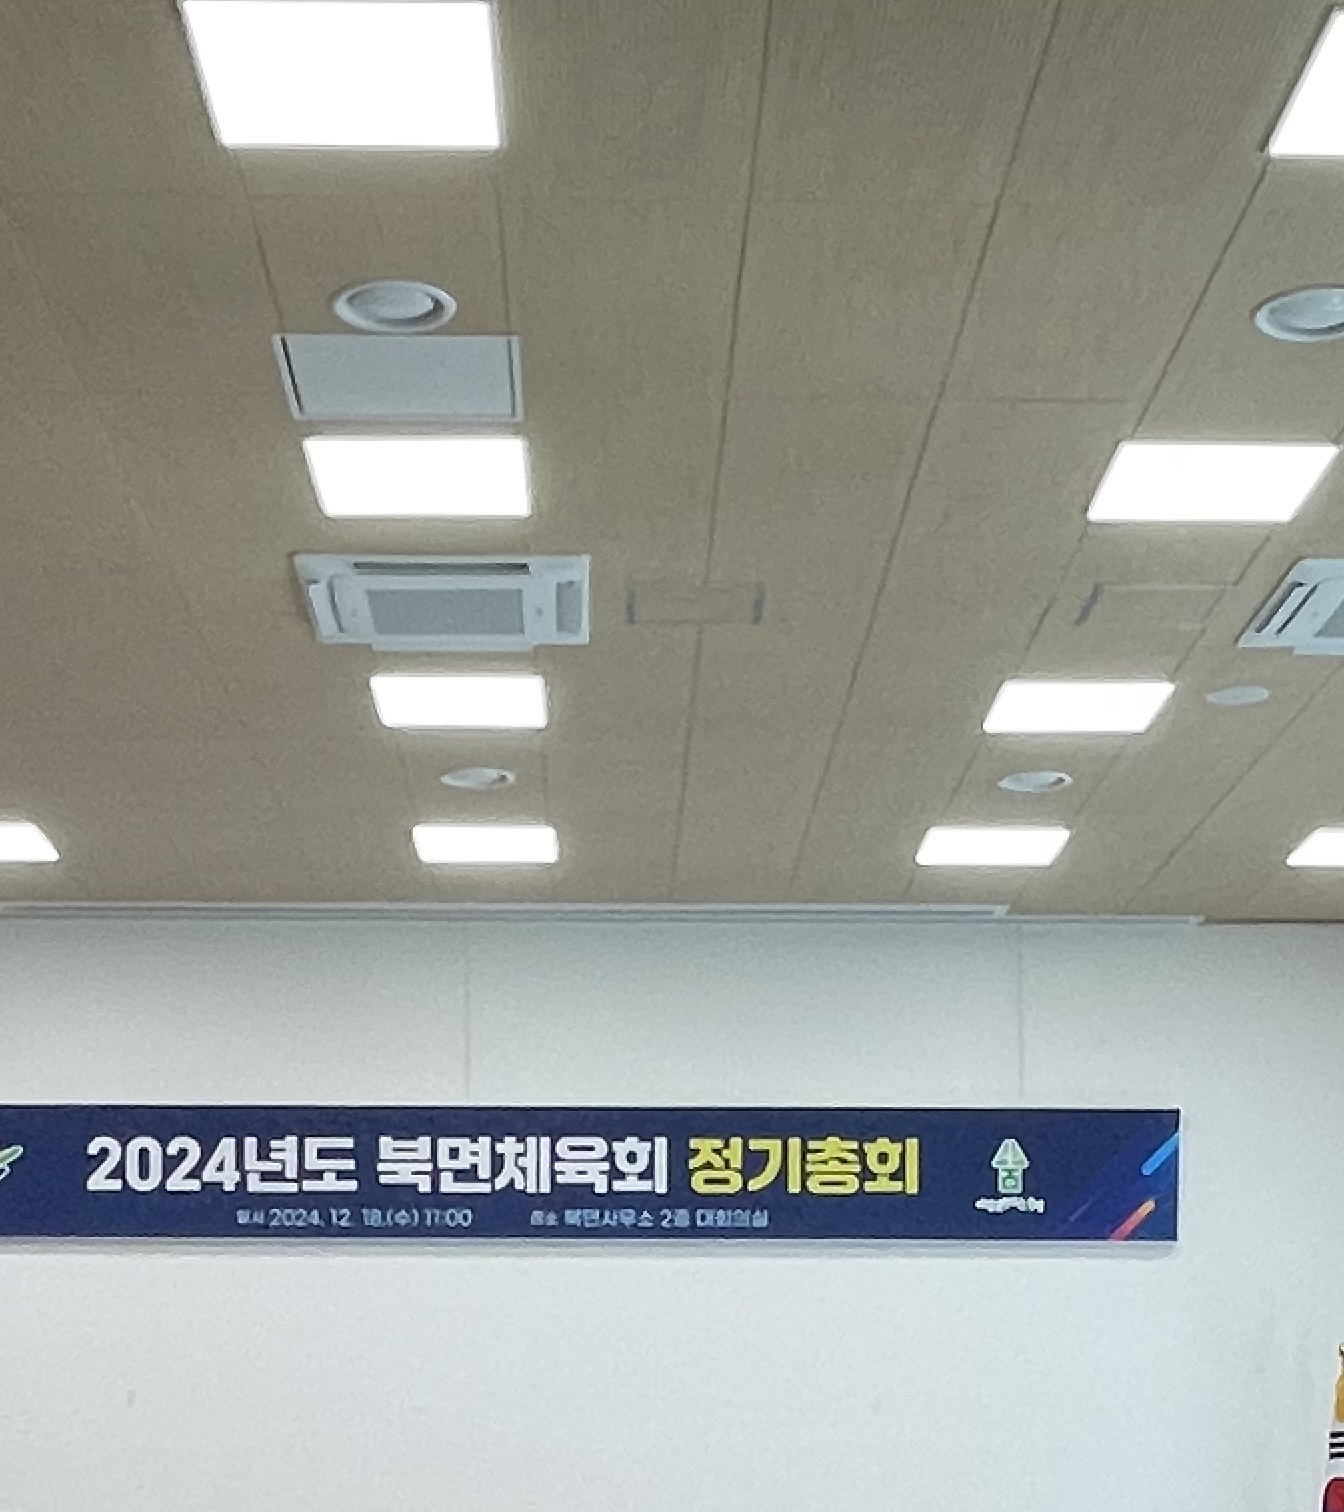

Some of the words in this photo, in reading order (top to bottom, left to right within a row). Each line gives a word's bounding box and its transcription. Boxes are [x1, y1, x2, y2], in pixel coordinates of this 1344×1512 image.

[86, 1135, 358, 1193] 2024년도
[376, 1135, 668, 1194] 북면체육회
[688, 1136, 919, 1194] 정기총회
